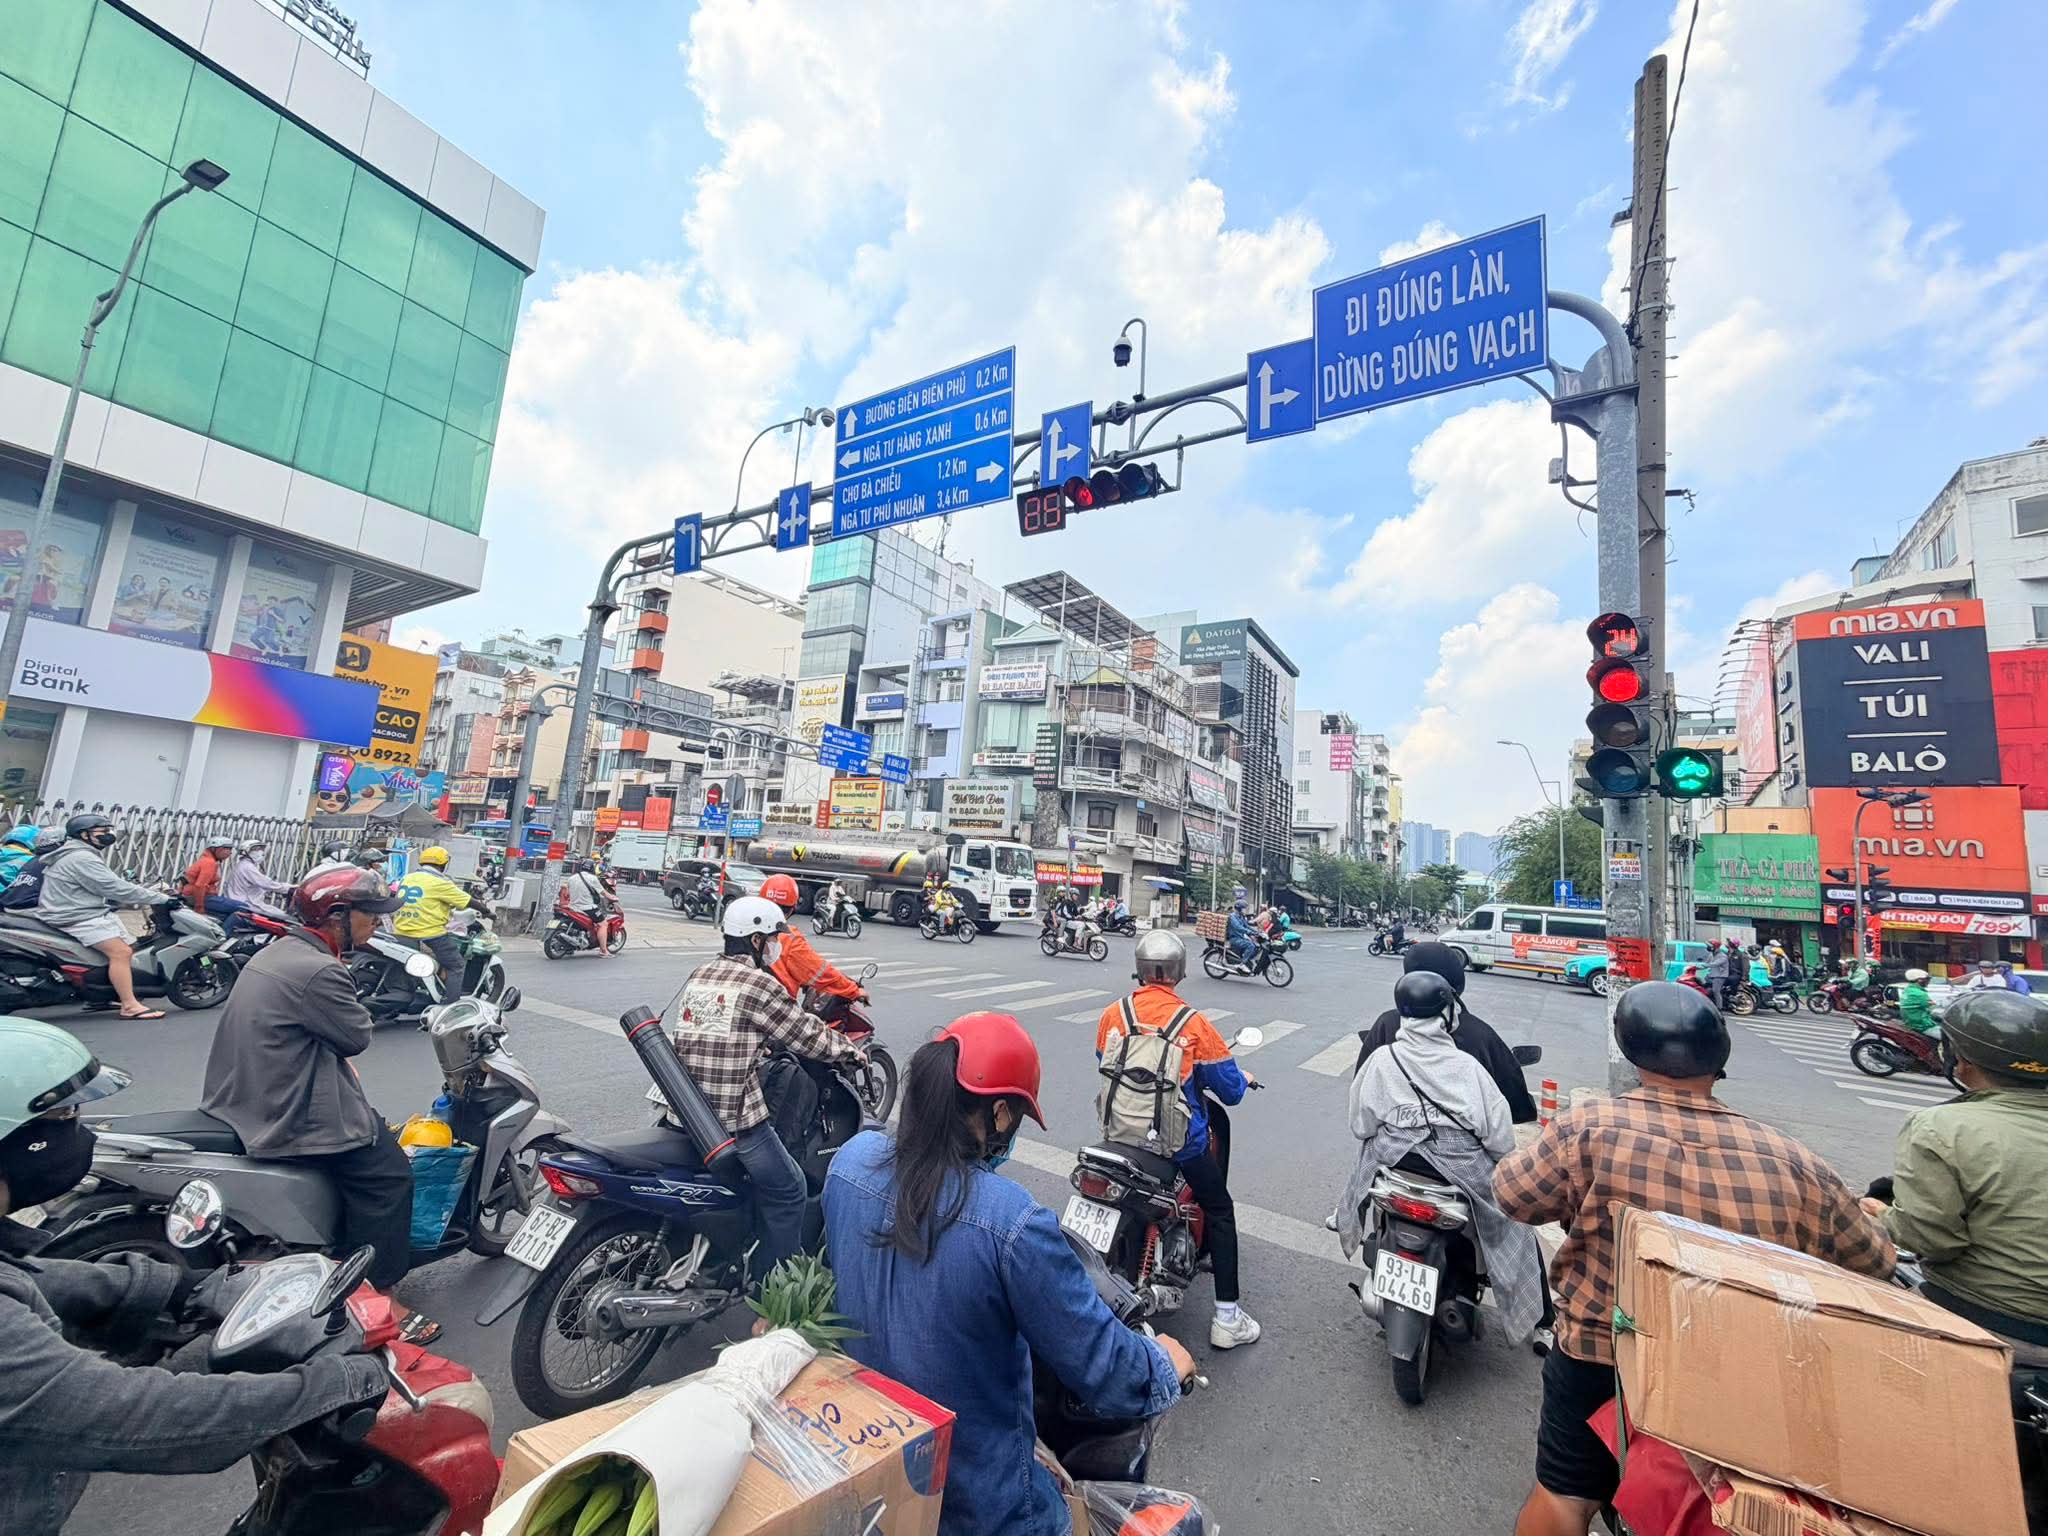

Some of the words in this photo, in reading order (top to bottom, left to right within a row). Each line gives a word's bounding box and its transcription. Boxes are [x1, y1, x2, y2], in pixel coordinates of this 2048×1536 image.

[1345, 293, 1368, 336] ĐI
[1376, 270, 1442, 327] ĐÚNG
[1452, 249, 1510, 305] LÀN,
[1323, 351, 1384, 404] DỪNG
[1391, 329, 1458, 385] ĐÚNG
[1468, 309, 1536, 369] VẠCH
[865, 400, 895, 425] ĐƯỜNG
[898, 390, 919, 415] ĐIỆN
[921, 383, 943, 406] BIÊN
[946, 371, 966, 399] PHỦ
[992, 365, 1008, 382] Km
[863, 441, 881, 464] NGÃ
[883, 438, 896, 458] TƯ
[897, 431, 922, 454] HÀNG
[925, 421, 952, 446] XANH
[991, 408, 1007, 425] Km
[842, 483, 860, 504] CHỢ
[861, 477, 873, 499] BÀ
[875, 467, 901, 496] CHIỂU
[952, 457, 967, 475] Km
[840, 509, 858, 531] NGÃ
[860, 507, 872, 527] TƯ
[873, 498, 891, 523] PHÚ
[893, 493, 926, 519] NHUẬN
[952, 487, 969, 504] Km
[1829, 607, 1957, 636] mia.vn
[24, 659, 78, 676] Digital
[1853, 641, 1930, 664] VALI
[20, 669, 91, 695] Bank
[1859, 688, 1928, 718] TÚI
[375, 711, 416, 728] CAO
[1851, 744, 1947, 773] BALÔ
[1855, 837, 1985, 859] mia.vn
[1523, 936, 1577, 946] LALAMOVE
[1385, 1256, 1427, 1288] 93-LA
[1378, 1275, 1432, 1311] 044.69
